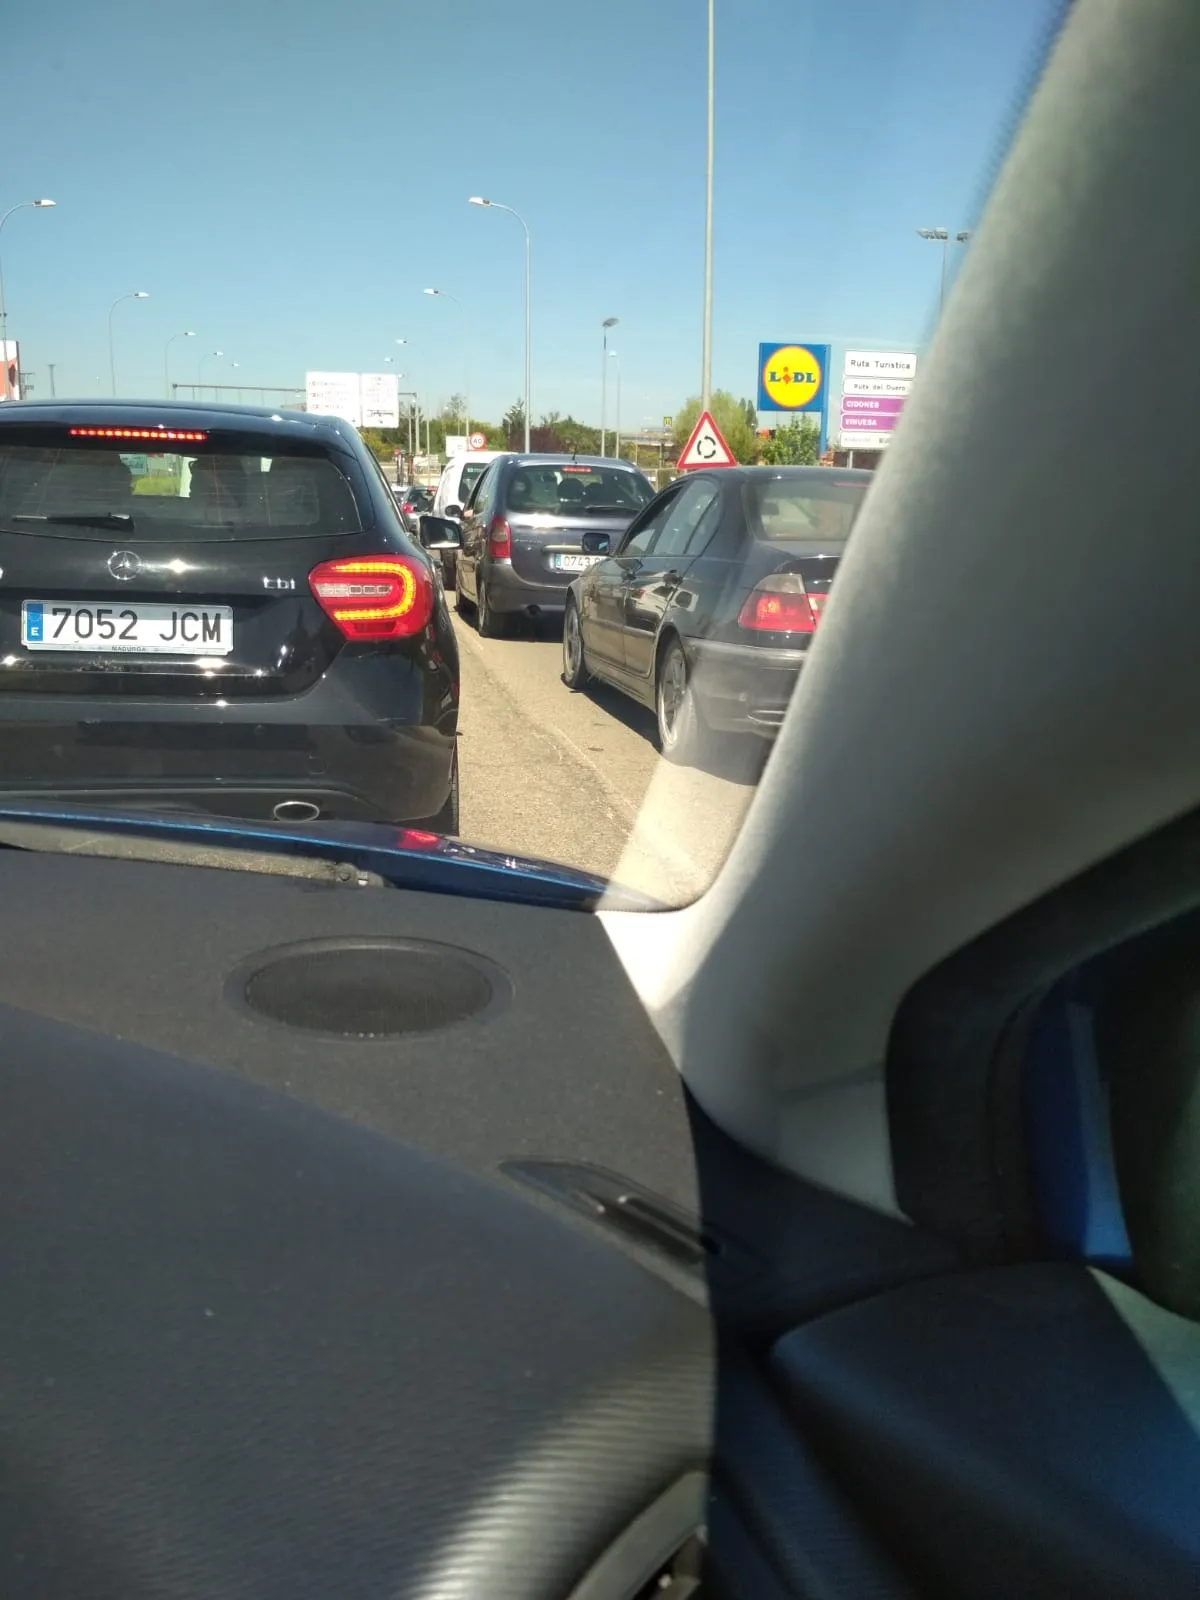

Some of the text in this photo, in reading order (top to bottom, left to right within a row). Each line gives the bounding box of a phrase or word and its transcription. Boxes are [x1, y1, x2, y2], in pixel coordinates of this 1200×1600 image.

[850, 360, 870, 368] Ruta
[52, 608, 221, 643] 7052 JCM
[31, 627, 39, 636] E
